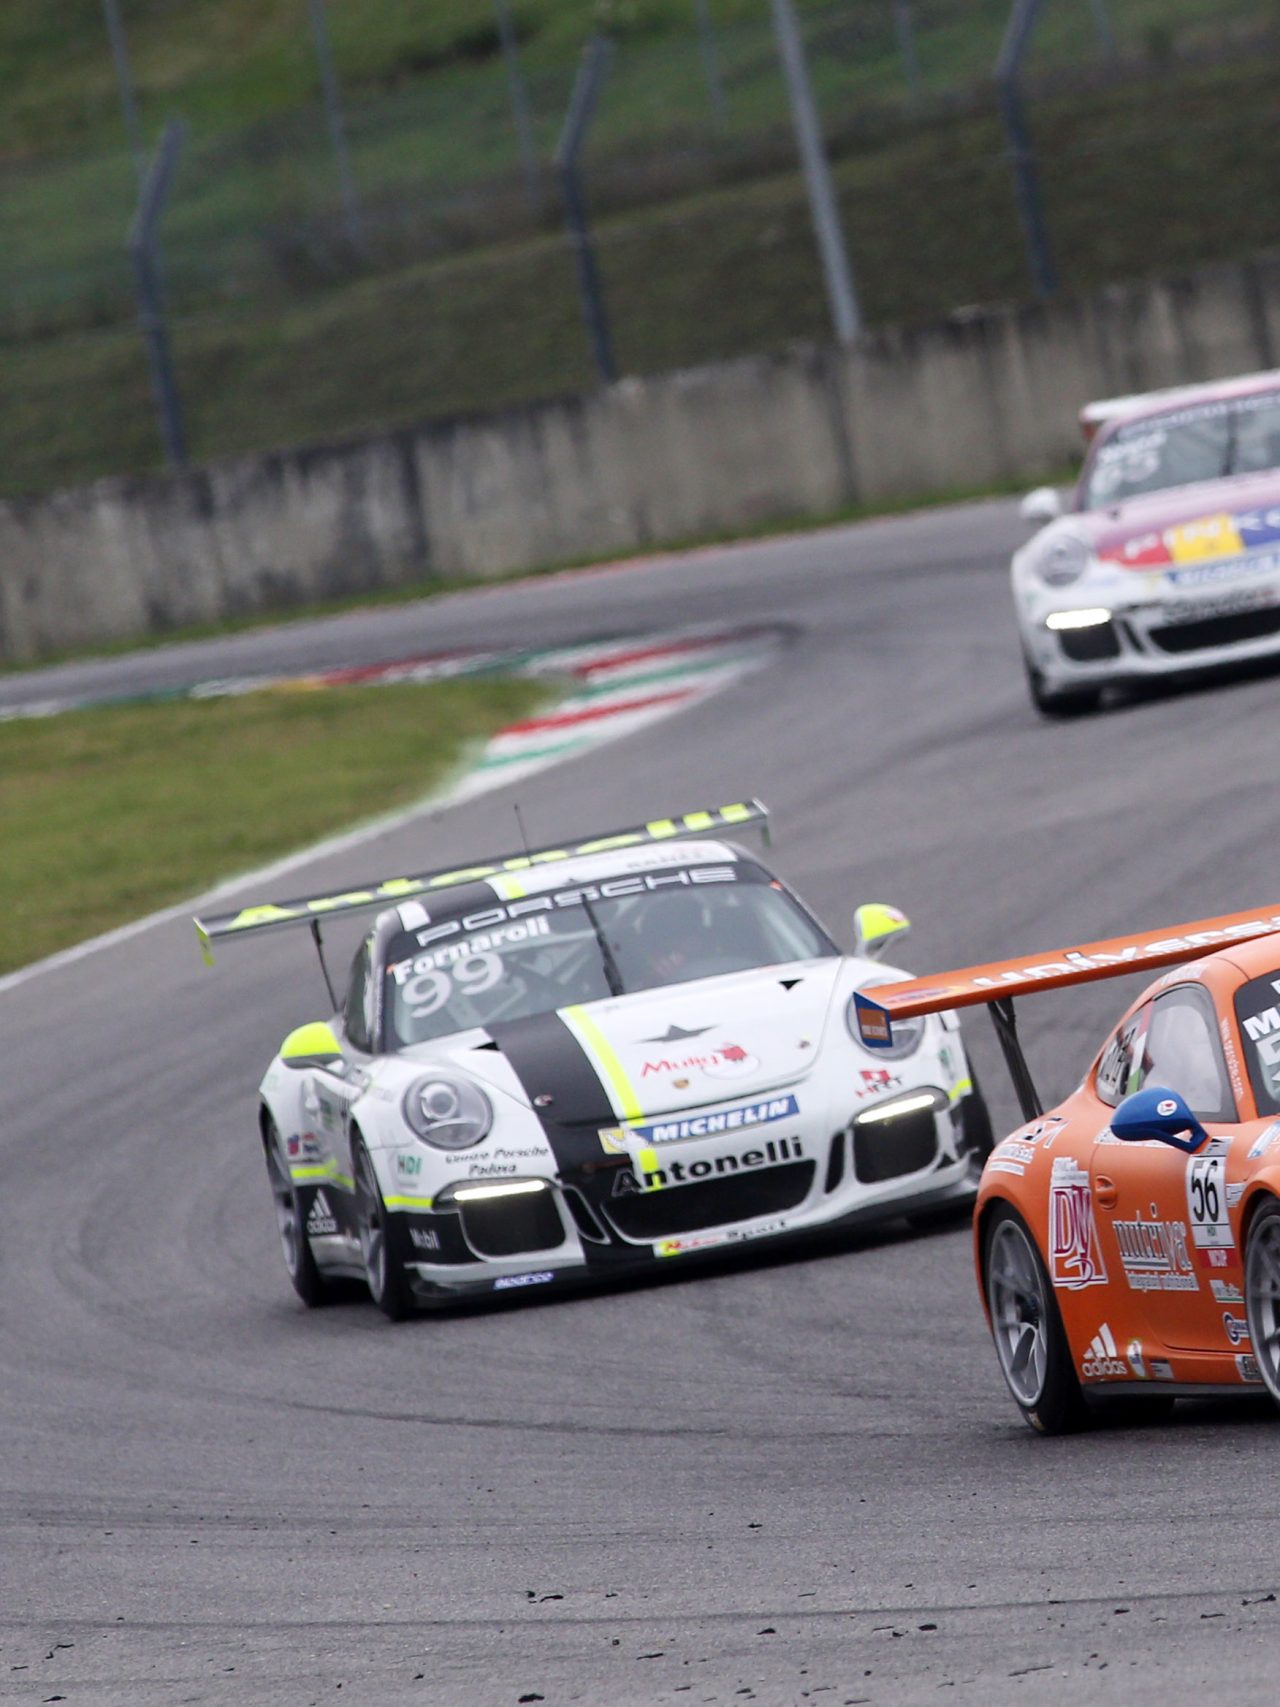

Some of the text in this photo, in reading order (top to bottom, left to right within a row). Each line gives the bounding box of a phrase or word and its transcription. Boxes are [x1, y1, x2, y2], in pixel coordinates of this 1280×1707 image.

[416, 866, 737, 947] PORSCHE
[393, 914, 550, 985] Fornaroli
[402, 952, 504, 1018] 99
[652, 1098, 790, 1142] MICHELIN
[611, 1136, 804, 1197] Antonelli
[1191, 1159, 1219, 1223] 56
[1082, 1355, 1127, 1377] adidas
